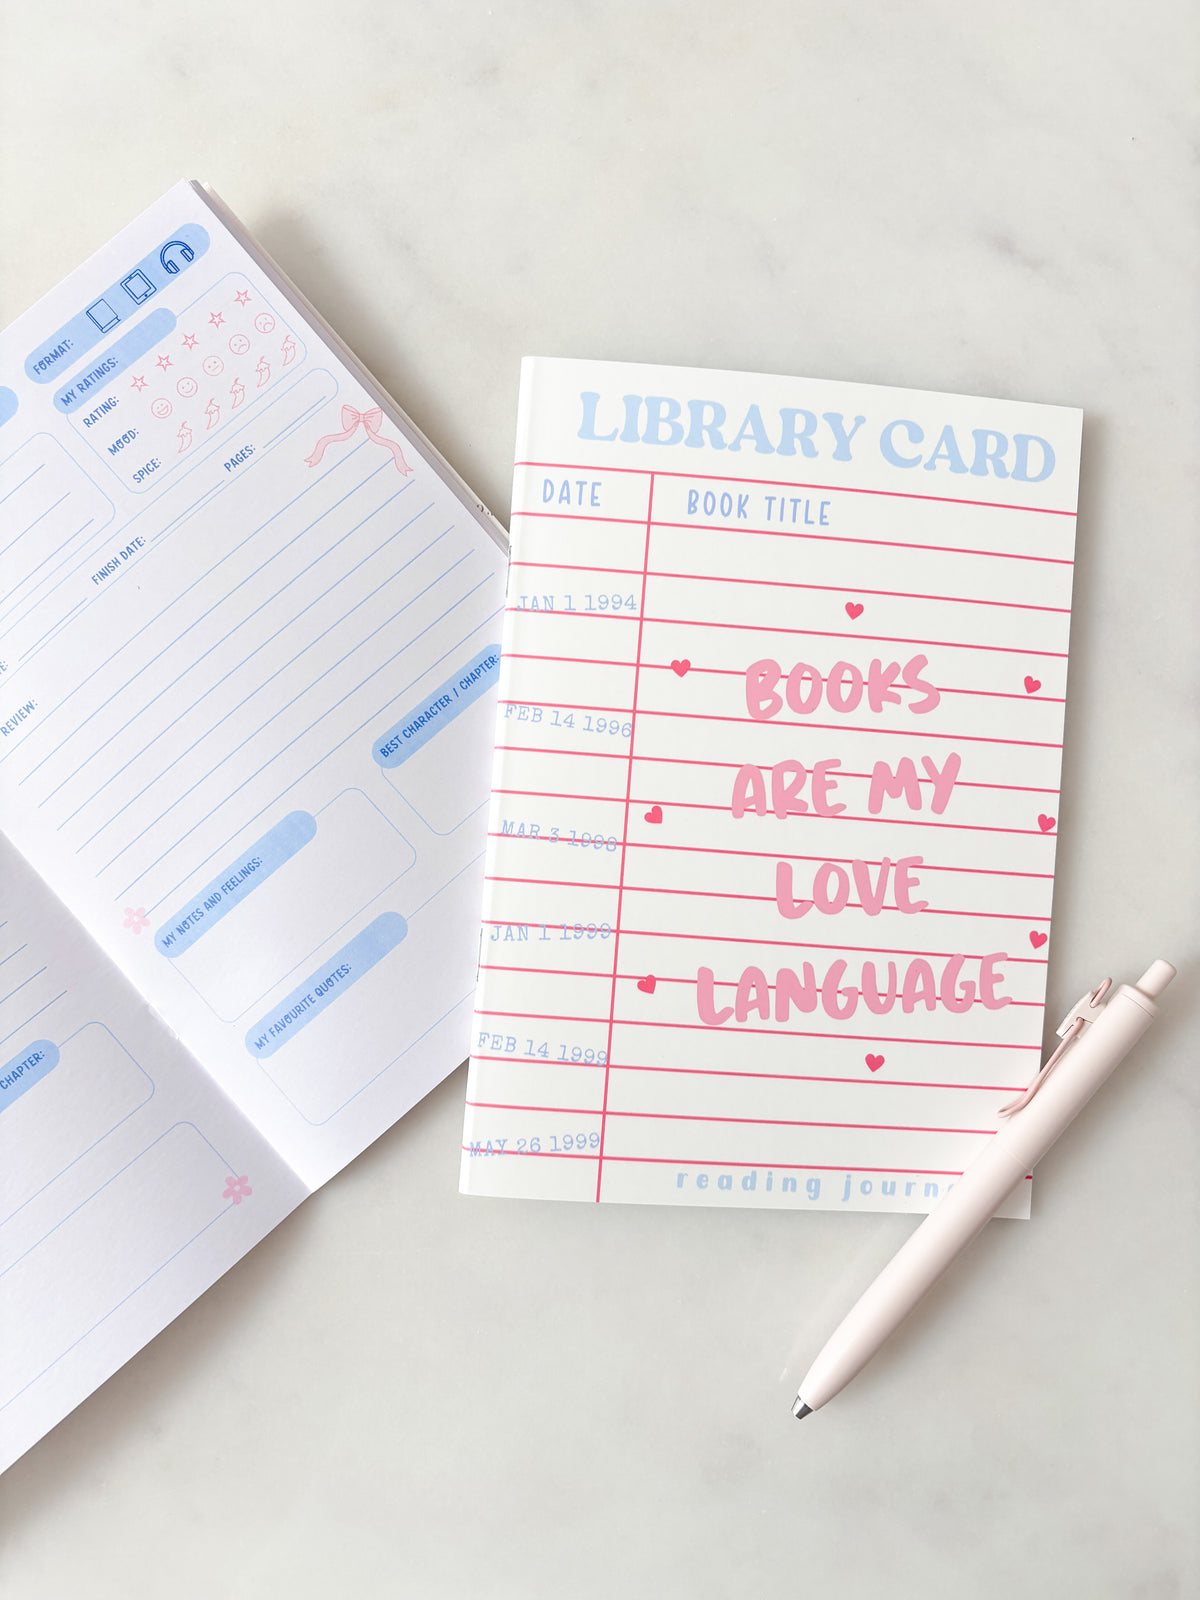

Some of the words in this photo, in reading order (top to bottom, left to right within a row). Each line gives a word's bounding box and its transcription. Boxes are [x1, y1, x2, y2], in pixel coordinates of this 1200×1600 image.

[33, 338, 75, 376] FORMAT:
[60, 388, 78, 407] MY
[76, 356, 119, 393] RATINGS:
[82, 395, 120, 428] RATING:
[107, 427, 140, 456] MOOD:
[577, 391, 866, 461] LIBRARY
[879, 419, 1056, 482] CARD
[132, 457, 162, 484] SPICE:
[223, 444, 257, 472] PAGES:
[542, 478, 602, 507] DATE
[687, 489, 749, 518] BOOK
[764, 496, 831, 526] TITLE
[91, 557, 121, 586] FINISH
[120, 536, 146, 561] DATE:
[516, 595, 555, 612] JAN
[564, 594, 576, 611] 1
[584, 594, 637, 611] 1994
[746, 654, 941, 720] BOOKS
[0, 699, 38, 737] REVIEW:
[379, 735, 403, 758] BEST
[402, 694, 453, 739] CHARACTER
[459, 654, 500, 690] CHAPTER:
[504, 704, 543, 723] FEB
[550, 710, 575, 729] 14
[582, 715, 633, 738] 1996
[732, 758, 847, 820] ARE
[868, 752, 962, 815] MY
[501, 820, 541, 840] MAR
[549, 828, 560, 843] 3
[567, 830, 618, 852] 1998
[161, 931, 177, 949] MY
[175, 907, 205, 936] NOTES
[203, 892, 222, 912] AND
[220, 856, 263, 895] FEELINGS:
[776, 855, 929, 920] LOVE
[490, 925, 529, 942] JAN
[538, 924, 551, 941] 1
[559, 923, 612, 941] 1999
[254, 1033, 270, 1050] MY
[268, 993, 315, 1038] FAVOURITE
[314, 963, 352, 998] QUOTES:
[697, 952, 1013, 1025] LANGUAGE
[477, 1032, 517, 1053] FEB
[524, 1040, 549, 1059] 14
[557, 1044, 608, 1067] 1999
[0, 1050, 46, 1090] CHAPTER:
[469, 1139, 508, 1157] MAY
[516, 1137, 541, 1154] 26
[549, 1132, 600, 1152] 1999
[676, 1170, 821, 1201] reading
[841, 1174, 954, 1202] journ
